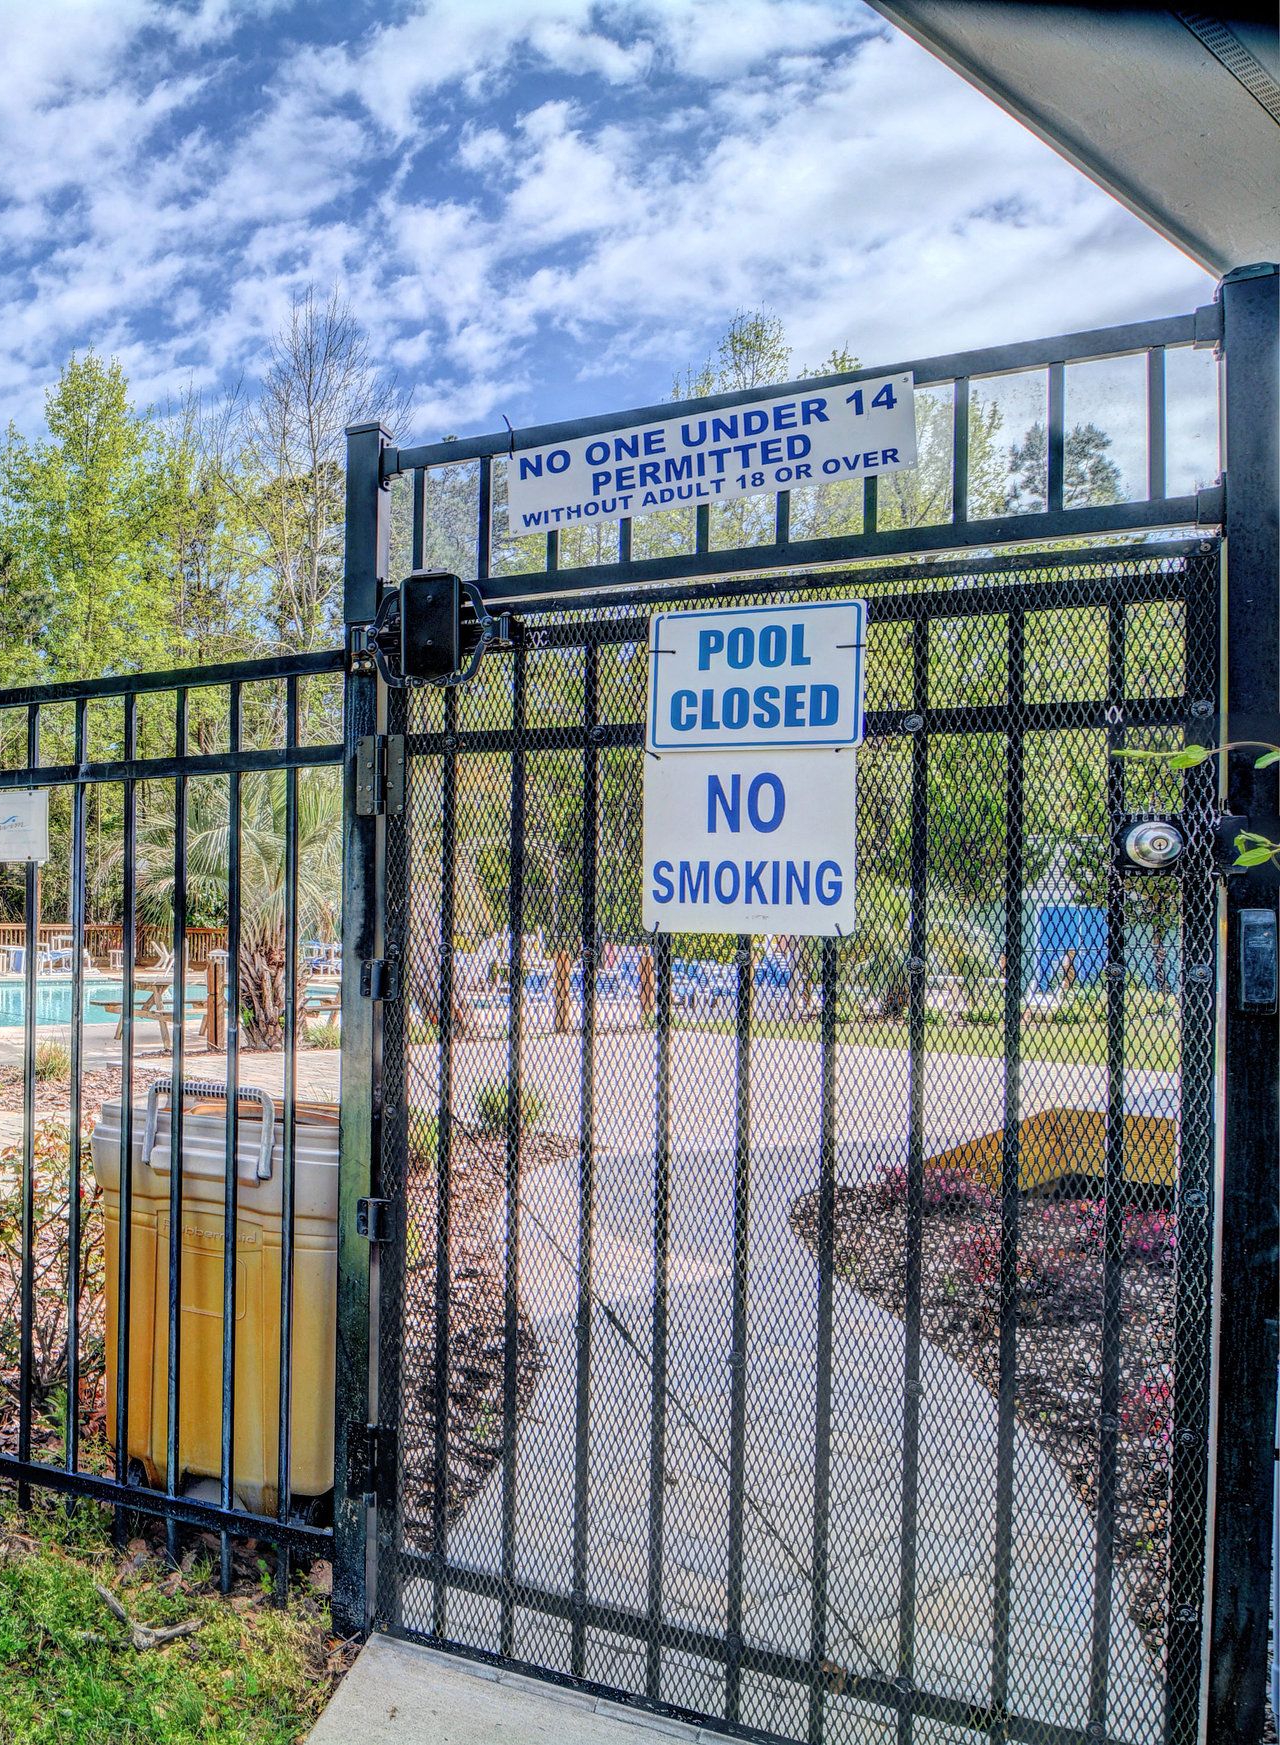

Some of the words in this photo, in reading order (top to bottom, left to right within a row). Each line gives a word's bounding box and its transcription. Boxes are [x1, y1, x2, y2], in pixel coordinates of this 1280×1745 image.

[518, 448, 572, 481] NO
[584, 428, 668, 467] ONE
[679, 397, 830, 449] UNDER
[846, 383, 898, 417] 14
[521, 495, 634, 528] WITHOUT
[642, 477, 726, 509] ADULT
[735, 471, 766, 490] 18
[774, 463, 812, 485] OR
[821, 447, 900, 475] OVER
[591, 433, 812, 496] PERMITTED
[697, 623, 812, 672] POOL
[669, 683, 840, 732] CLOSED
[707, 771, 786, 834] NO
[652, 859, 843, 907] SMOKING
